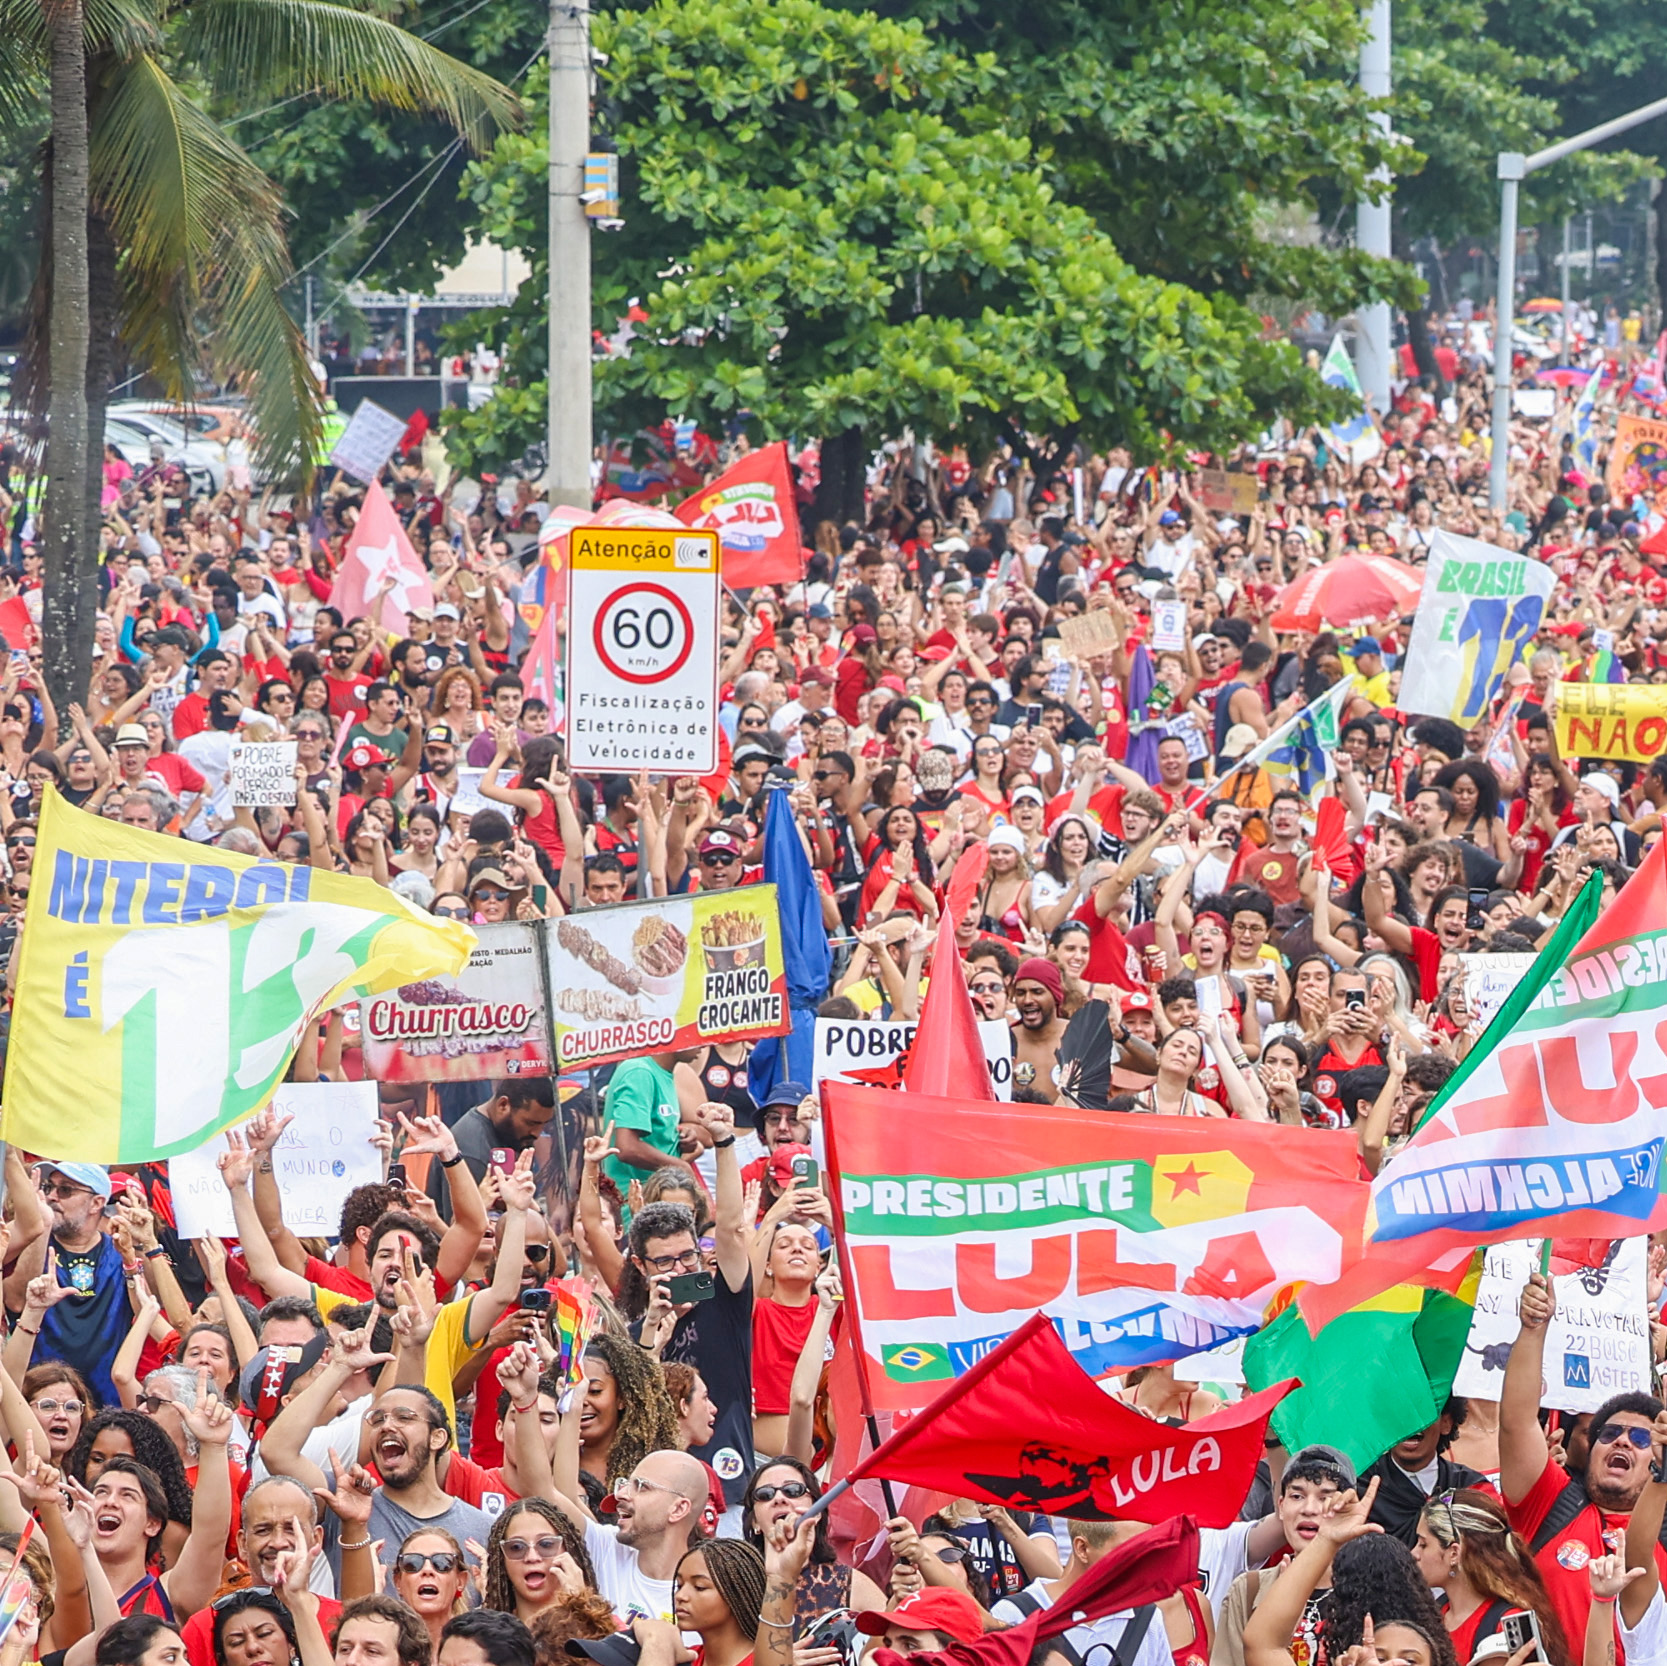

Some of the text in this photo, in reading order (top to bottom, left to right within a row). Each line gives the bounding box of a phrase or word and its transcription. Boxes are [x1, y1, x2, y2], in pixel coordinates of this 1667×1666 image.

[578, 540, 673, 565] Atenção
[1436, 558, 1528, 597] BRASIL
[613, 607, 674, 649] 60
[628, 657, 660, 668] km/h
[580, 694, 706, 714] Fiscalização
[1562, 684, 1627, 716] ELE
[576, 717, 708, 736] Eletrônica de
[244, 745, 282, 765] POBRE
[588, 743, 696, 761] Velocidade
[233, 765, 282, 779] FORMADO
[48, 847, 313, 927] NITERÓI
[64, 948, 92, 1019] É
[706, 968, 769, 1002] FRANGO
[368, 998, 537, 1039] Churrasco
[700, 995, 783, 1031] CROCANTE
[563, 1018, 673, 1057] CHURRASCO
[850, 1163, 1137, 1217] PRESIDENTE
[849, 1227, 1278, 1322] LULA
[1552, 1307, 1646, 1337] PRA VOTAR
[1565, 1334, 1586, 1353] 22
[1110, 1434, 1223, 1511] LULA
